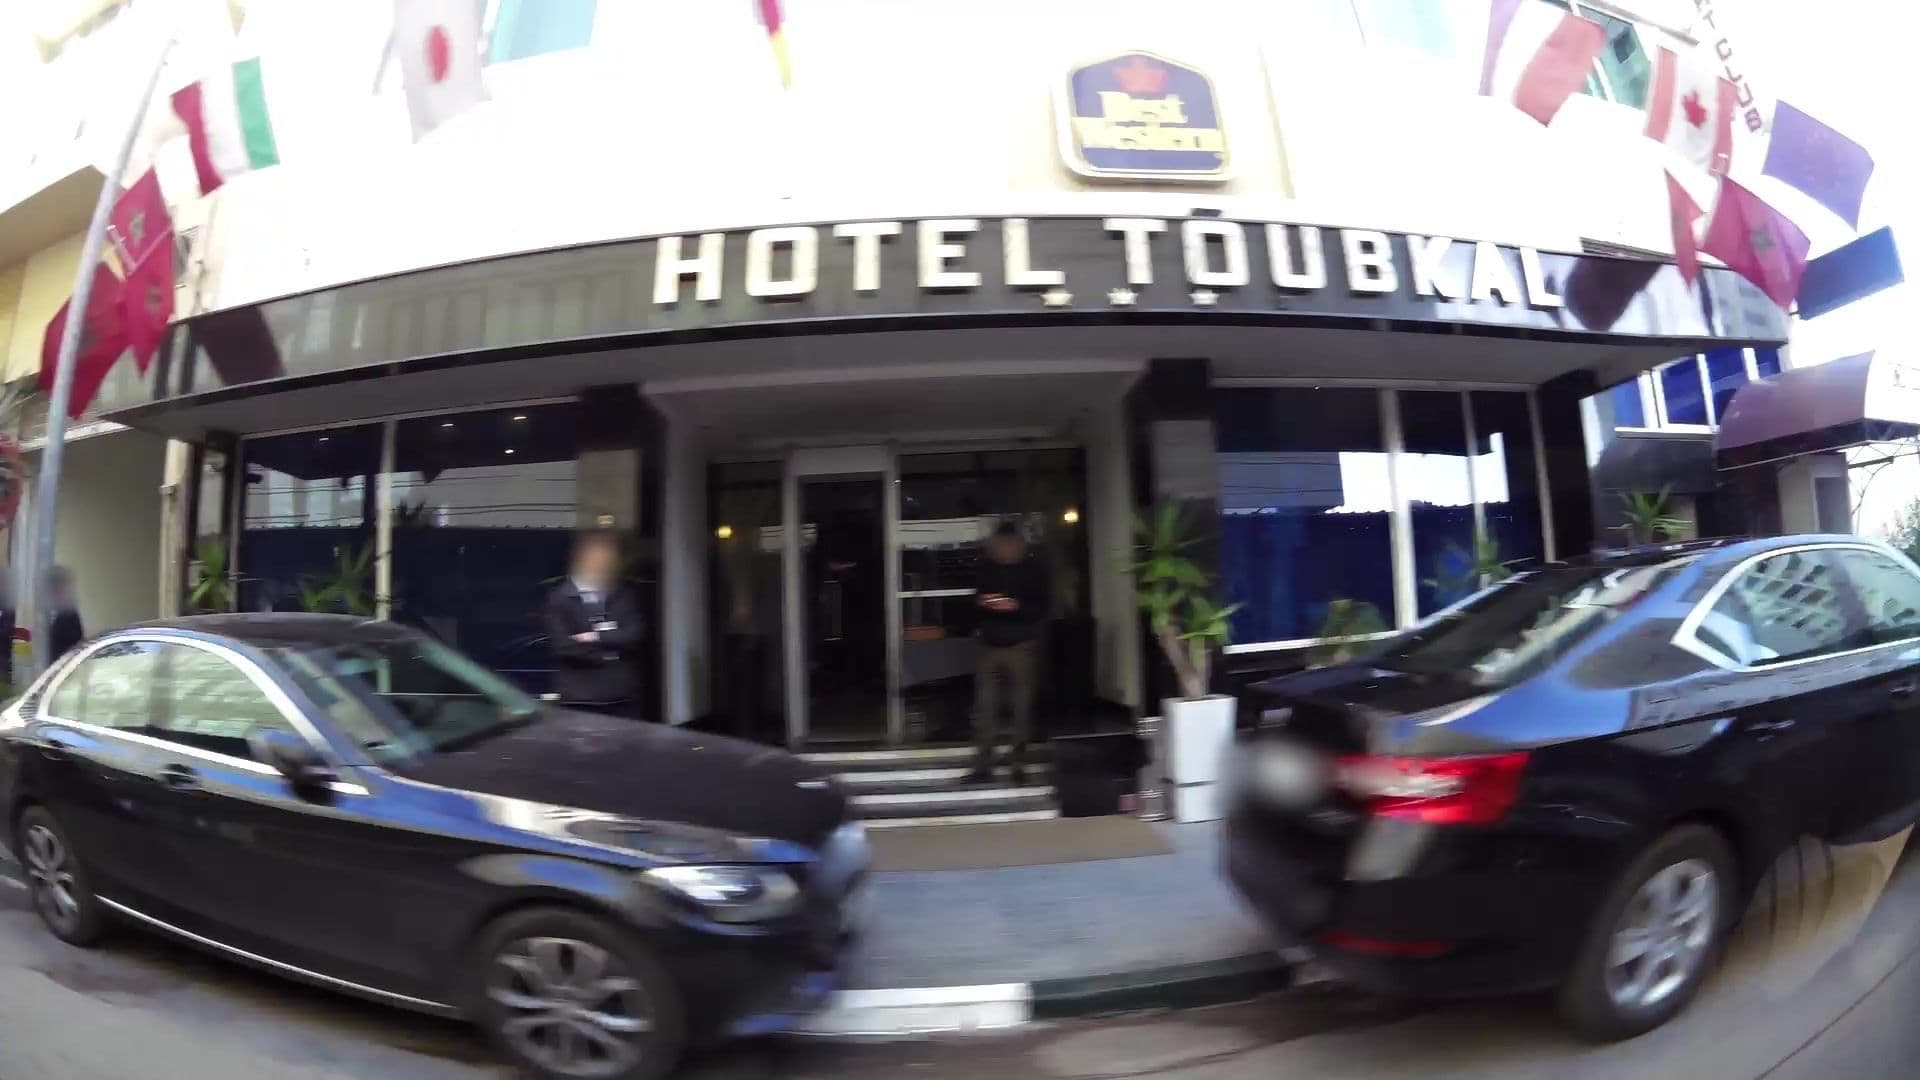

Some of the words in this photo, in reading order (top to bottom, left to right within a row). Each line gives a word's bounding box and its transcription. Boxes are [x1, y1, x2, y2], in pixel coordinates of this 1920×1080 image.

[1097, 91, 1188, 124] Best
[1715, 38, 1763, 134] CLUB
[652, 217, 1065, 305] HOTEL
[1103, 216, 1564, 309] TOUBKAL
